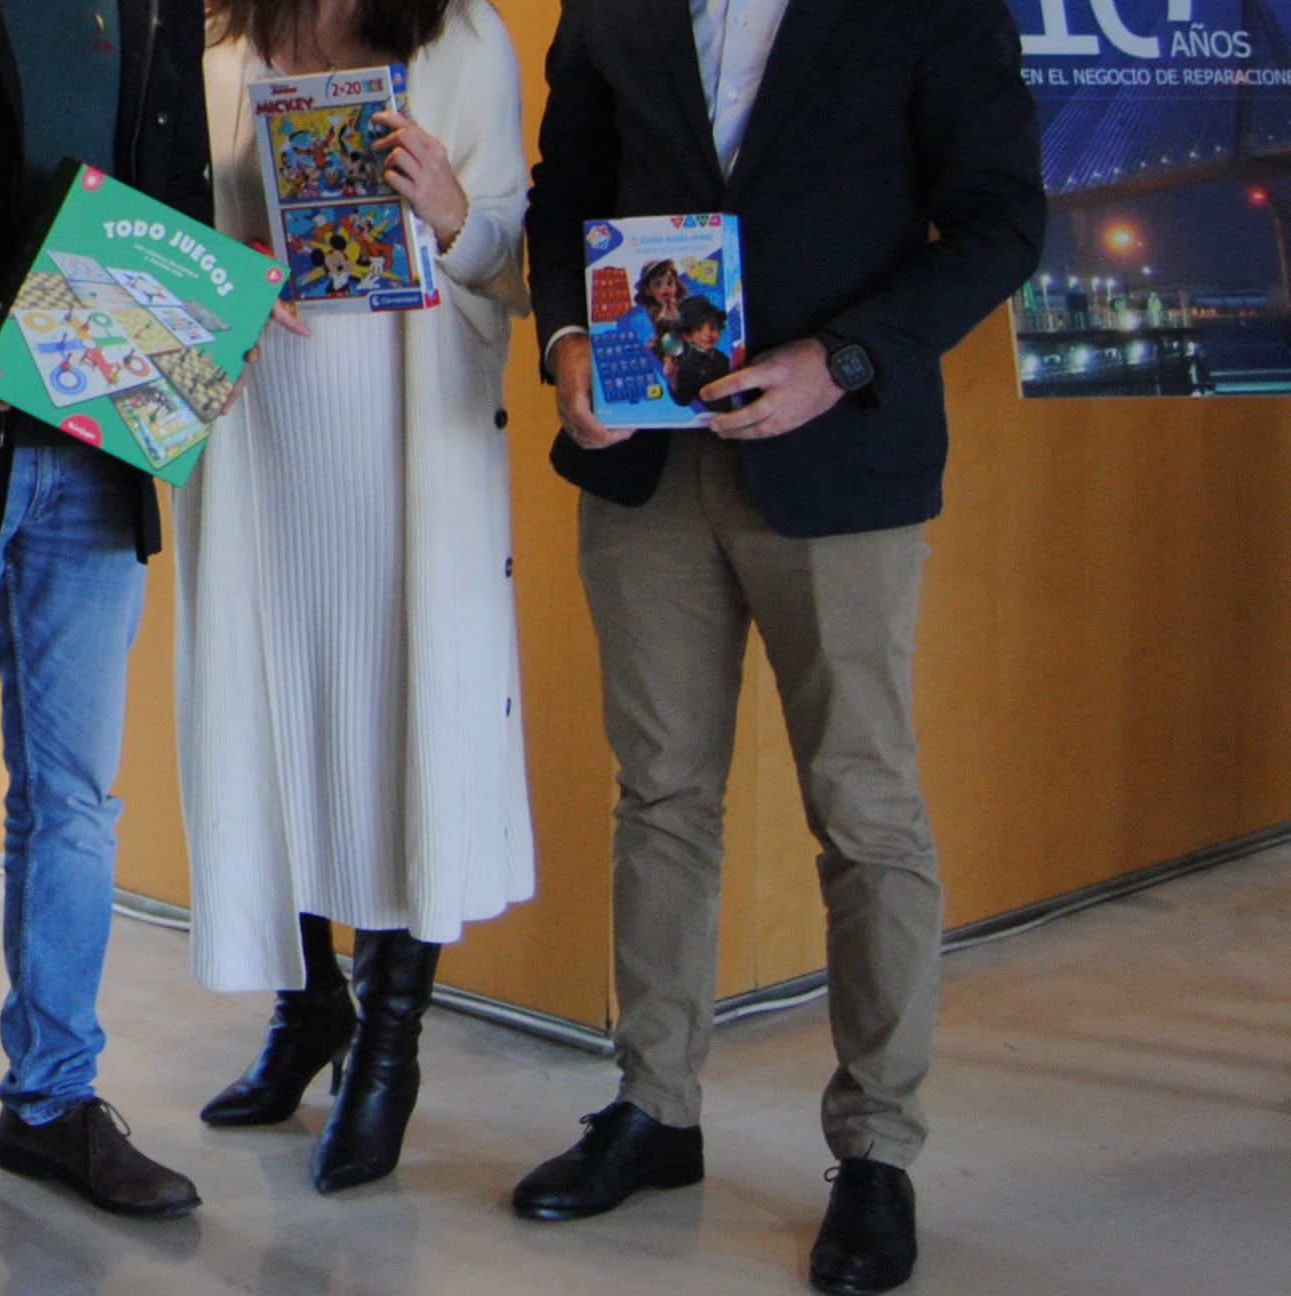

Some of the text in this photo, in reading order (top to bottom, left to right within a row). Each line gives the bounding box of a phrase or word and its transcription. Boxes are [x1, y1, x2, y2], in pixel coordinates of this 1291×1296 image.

[1171, 23, 1252, 58] AÑOS
[1021, 68, 1043, 85] EN
[1049, 68, 1069, 85] EL
[1073, 68, 1150, 85] NEGOCIO
[1156, 68, 1178, 85] DE
[256, 96, 315, 115] MICKEY
[103, 219, 167, 241] TODO
[169, 230, 235, 297] JUEGOS
